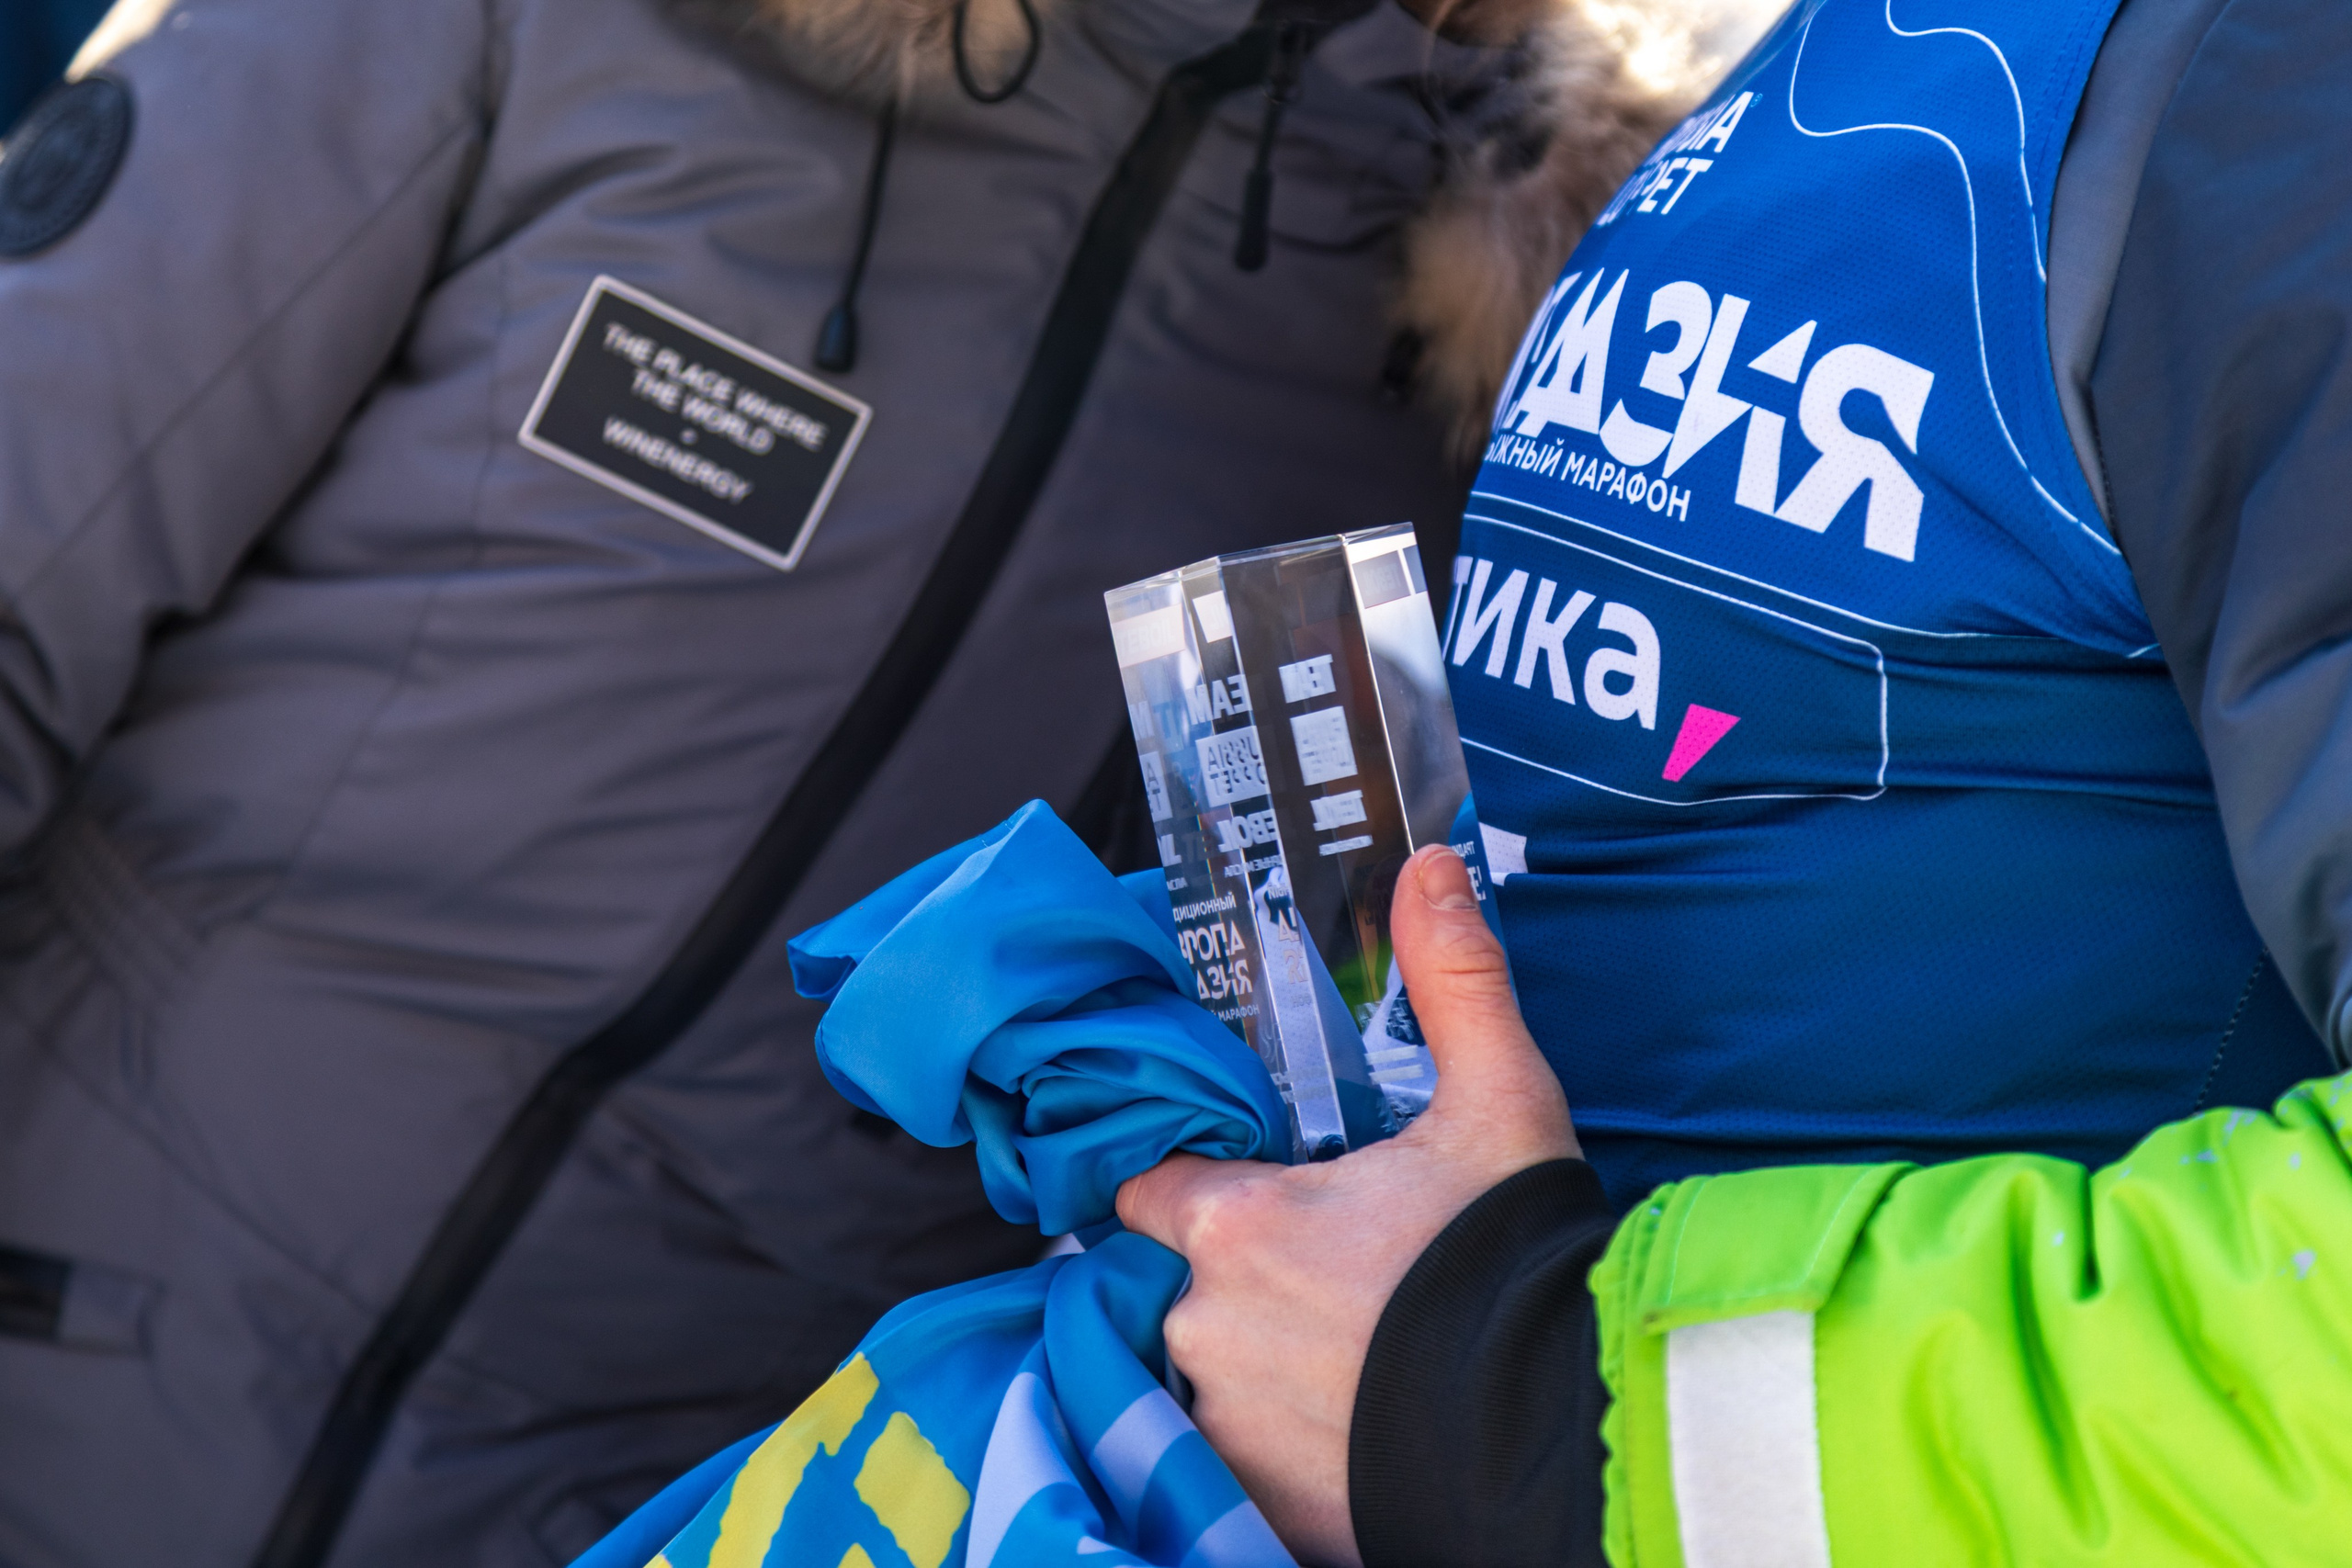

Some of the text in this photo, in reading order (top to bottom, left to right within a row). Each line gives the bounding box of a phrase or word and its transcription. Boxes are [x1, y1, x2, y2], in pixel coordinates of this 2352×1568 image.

[603, 321, 828, 451] THE PLACE WHERE
[632, 368, 775, 455] THE WORLD
[603, 415, 753, 502] WINENERGY
[1560, 451, 1692, 522] МАРАФОН
[1217, 1003, 1261, 1021] МАРАФОН
